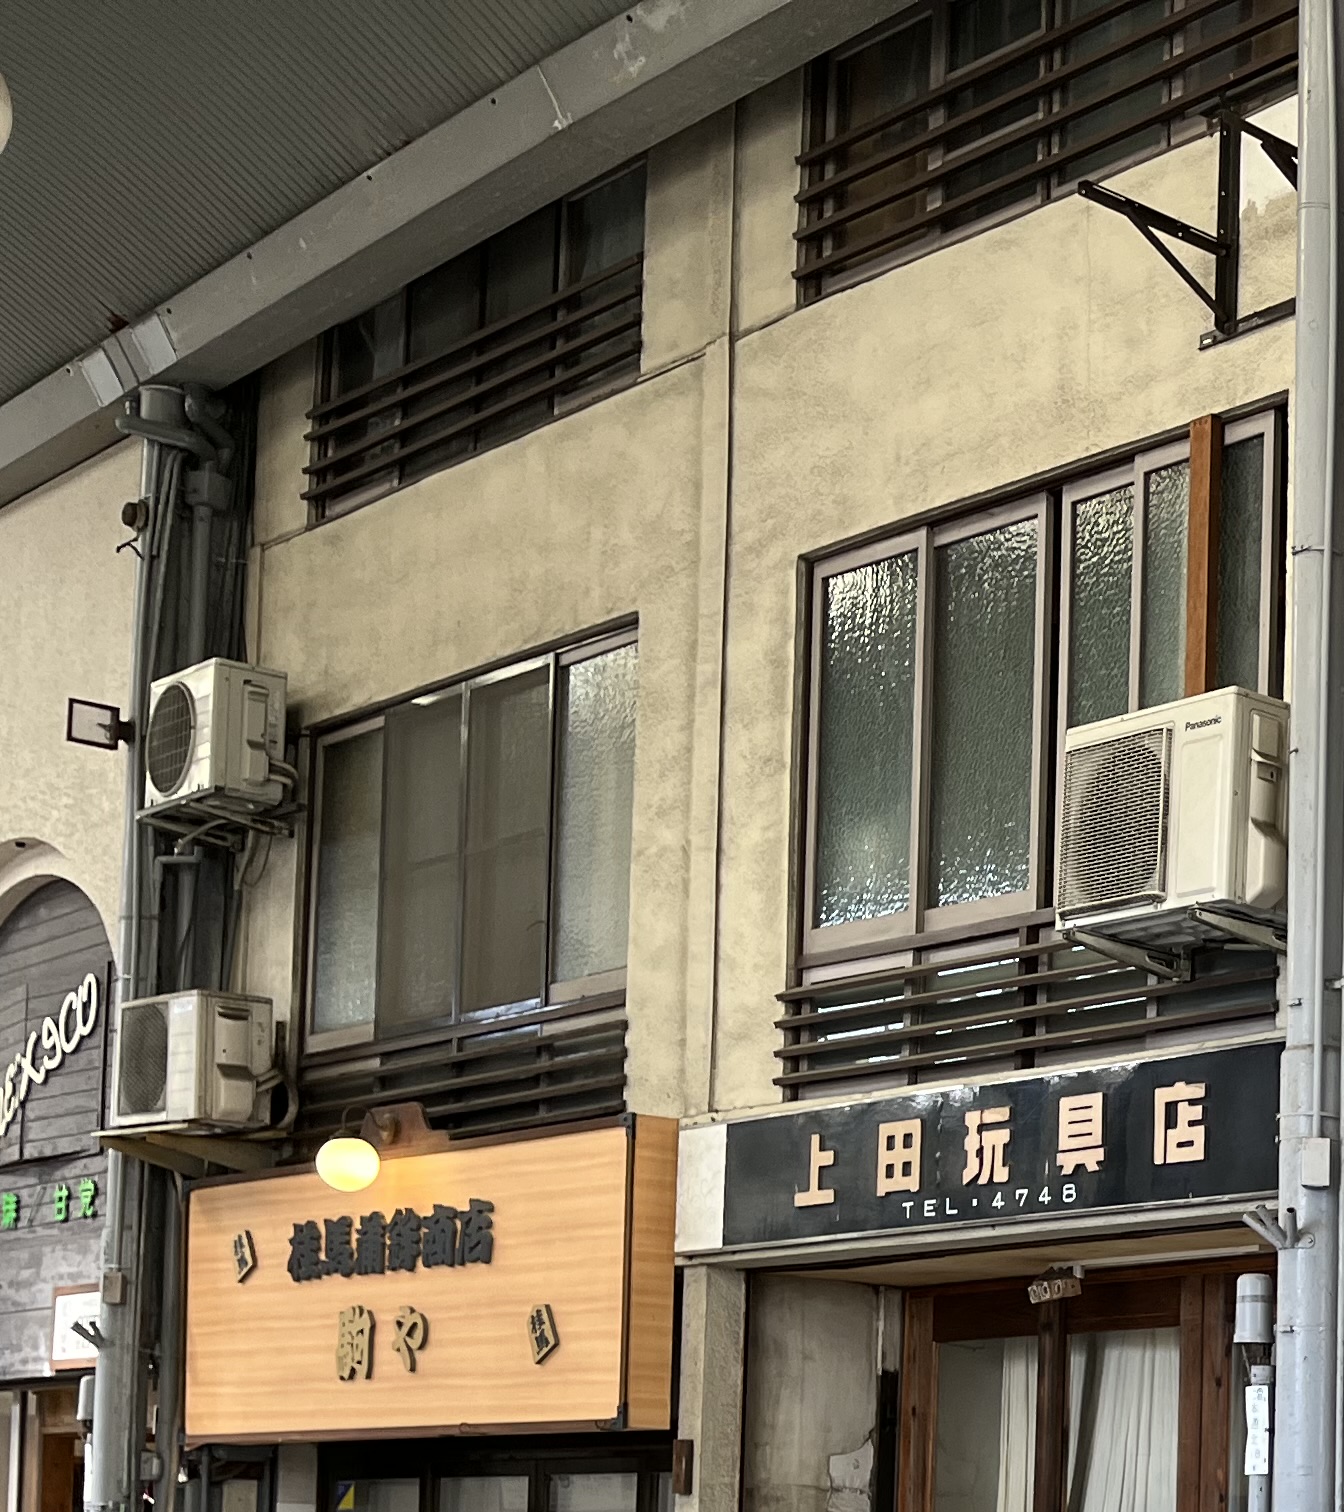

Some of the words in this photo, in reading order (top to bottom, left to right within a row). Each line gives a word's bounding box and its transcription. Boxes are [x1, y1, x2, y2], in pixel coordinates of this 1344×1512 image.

[1184, 715, 1222, 732] Panasonic
[793, 1080, 1206, 1208] 上田玩具店
